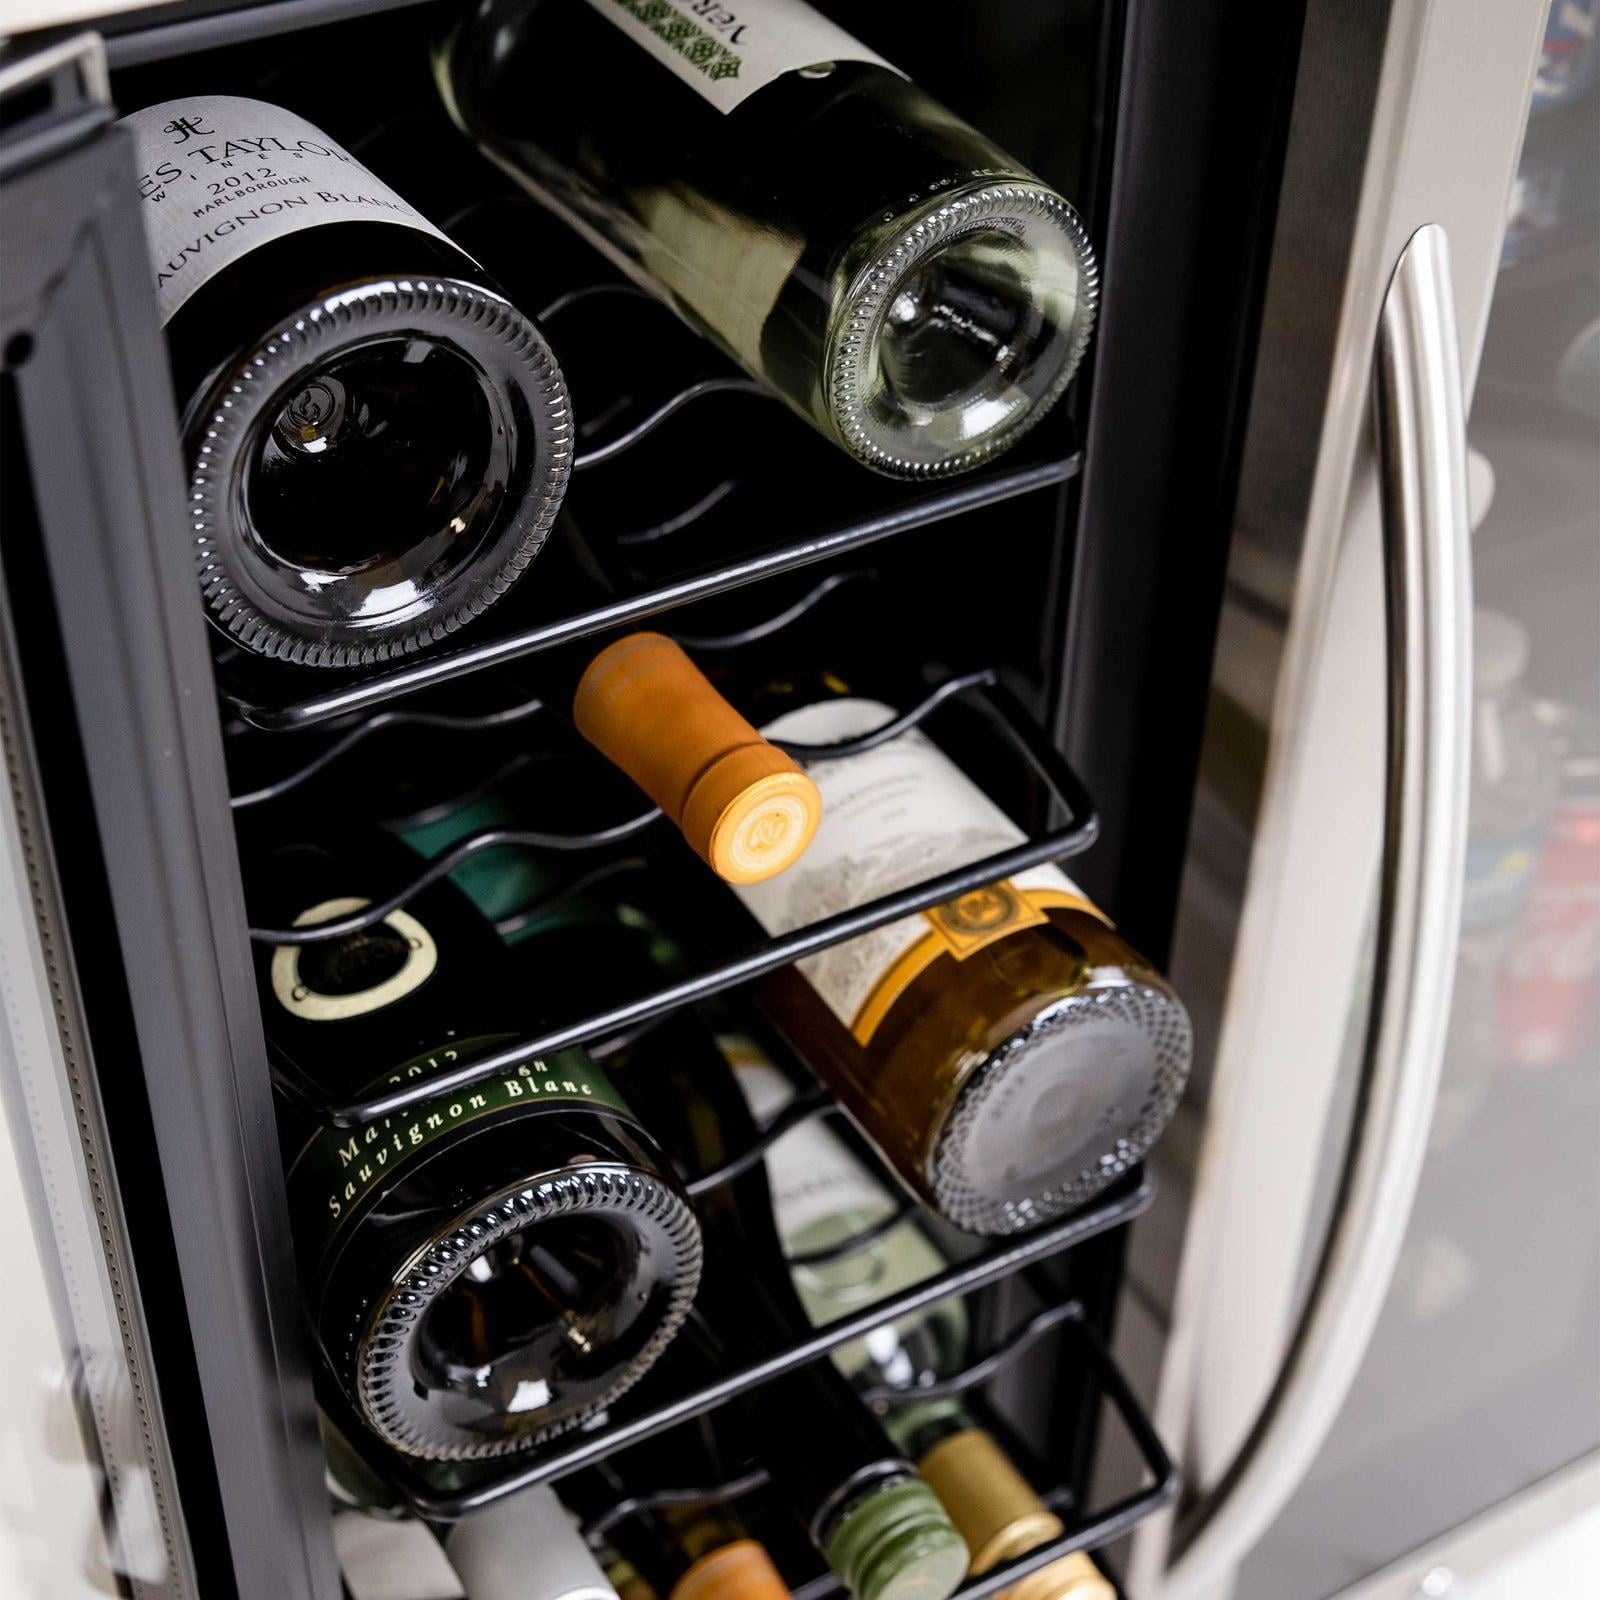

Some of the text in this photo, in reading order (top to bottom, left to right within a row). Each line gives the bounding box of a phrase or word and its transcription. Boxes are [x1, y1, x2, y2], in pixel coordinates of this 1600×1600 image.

[138, 162, 183, 201] ES
[192, 176, 311, 218] MARLBOROUGH
[206, 167, 277, 196] 2012
[156, 196, 309, 288] AUVIGNON
[328, 1094, 487, 1218] Sauvignon
[503, 1076, 592, 1097] Blanc
